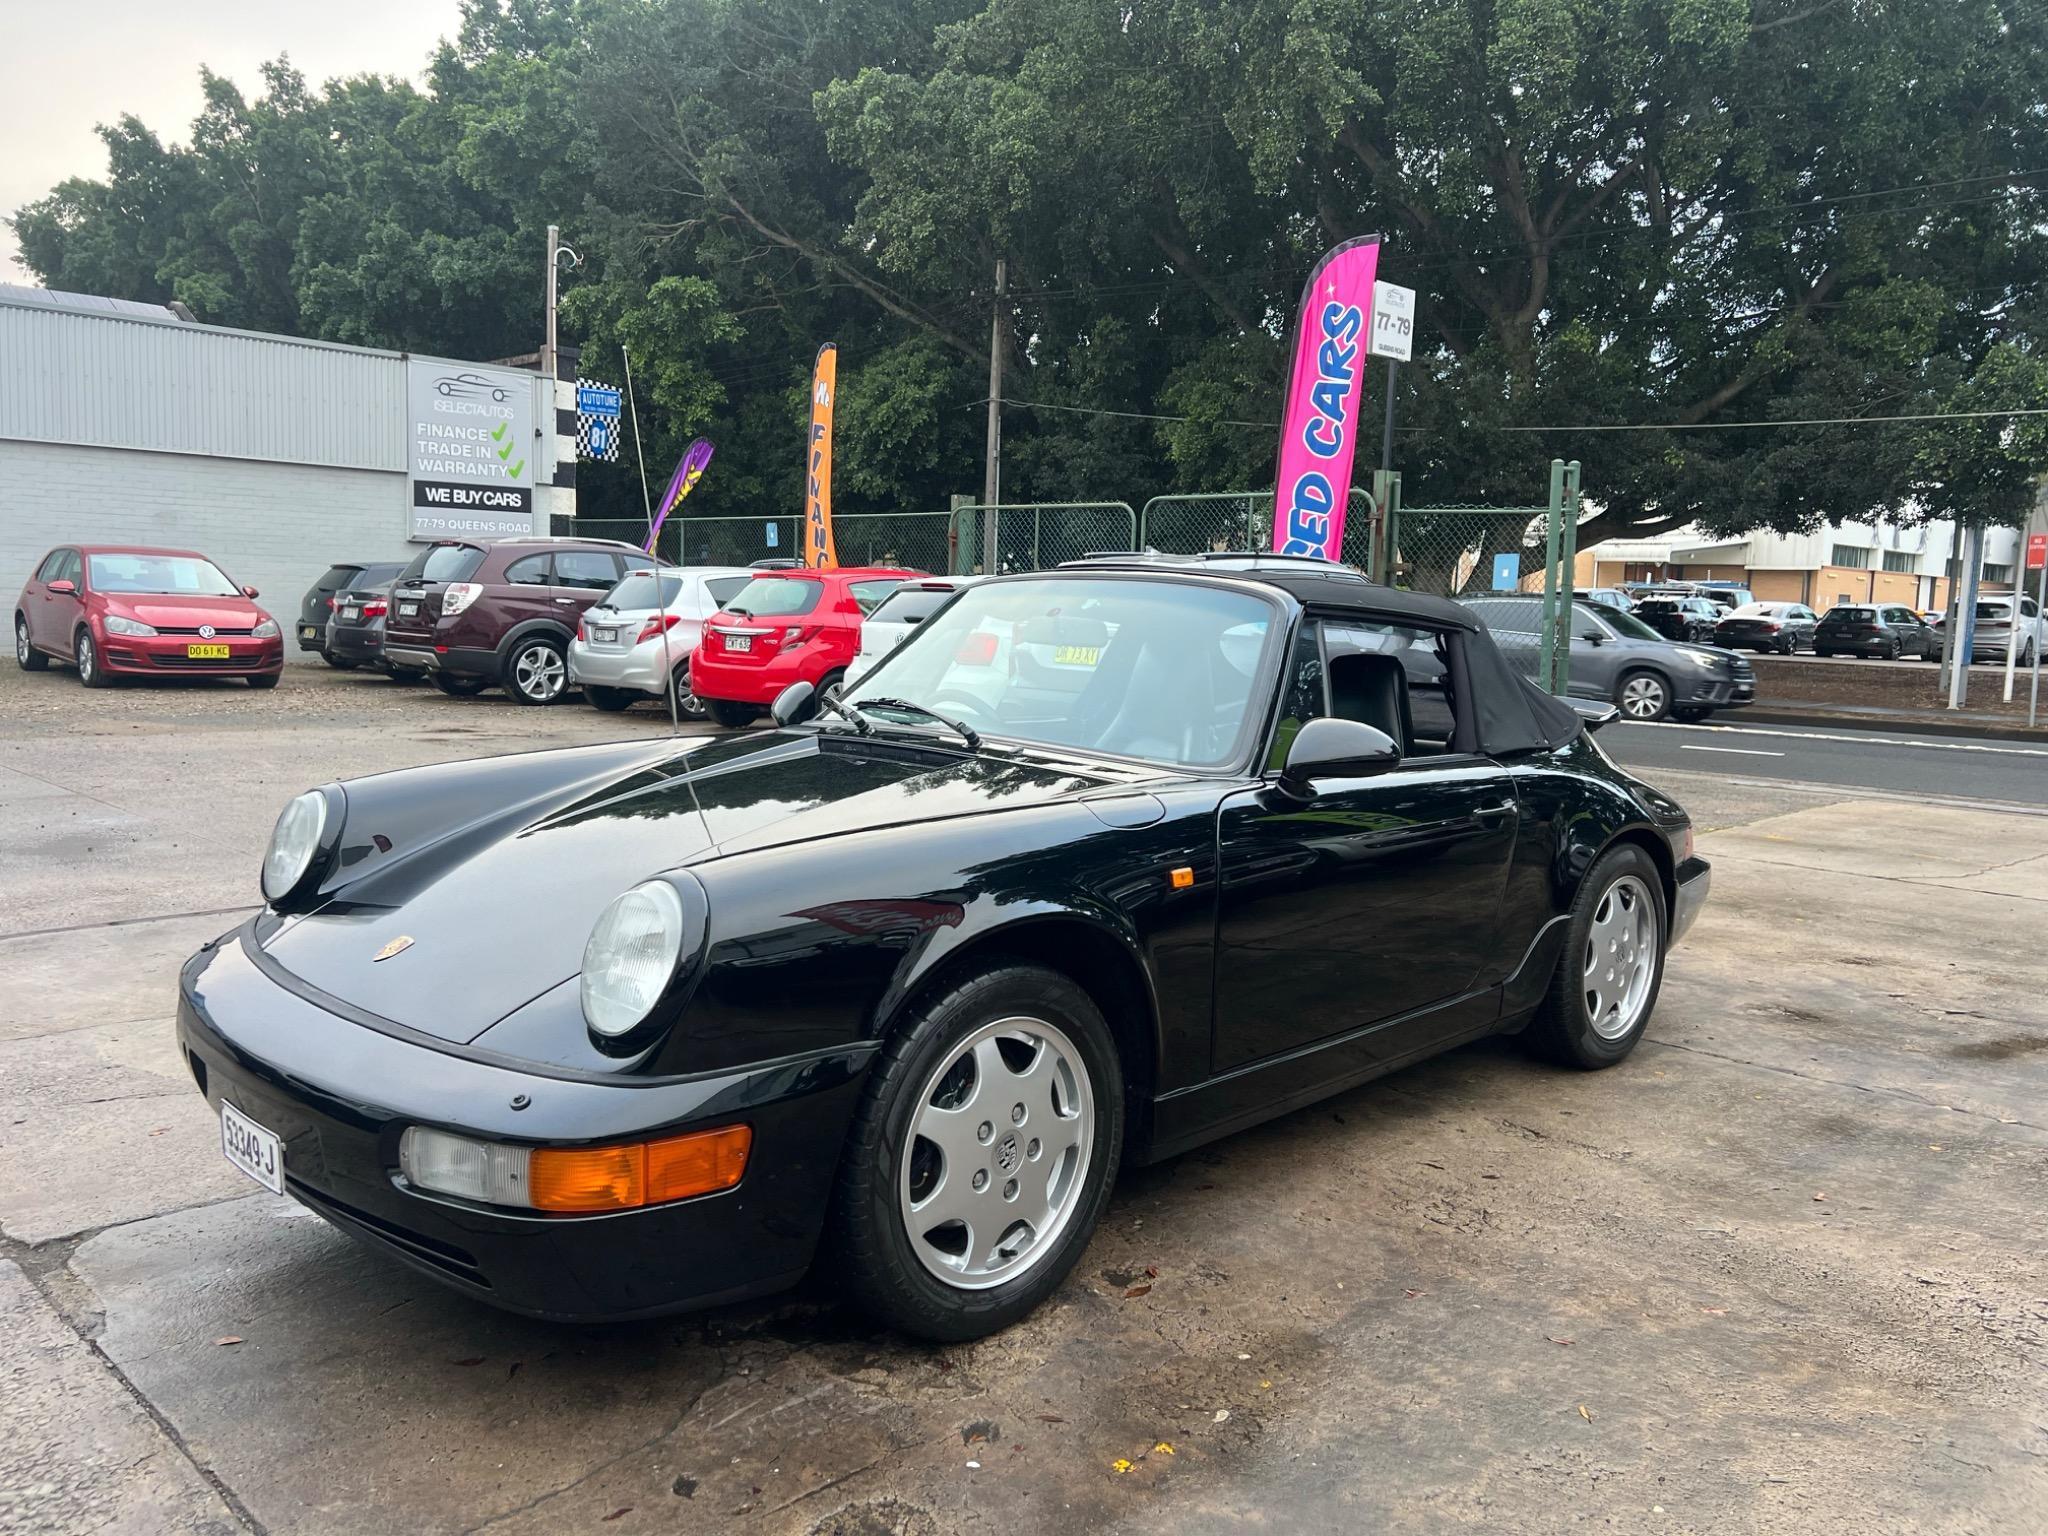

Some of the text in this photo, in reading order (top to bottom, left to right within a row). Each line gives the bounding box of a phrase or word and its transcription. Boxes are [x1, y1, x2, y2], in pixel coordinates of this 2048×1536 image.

[1376, 310, 1411, 336] 77-79
[1303, 301, 1363, 459] CARS
[417, 422, 489, 442] FINANCE
[590, 427, 606, 450] 81
[417, 440, 492, 459] TRADE IN
[417, 459, 508, 478] WARRANTY
[425, 487, 522, 507] WE BUY CARS
[415, 518, 531, 533] 77-79 QUEENS ROAD
